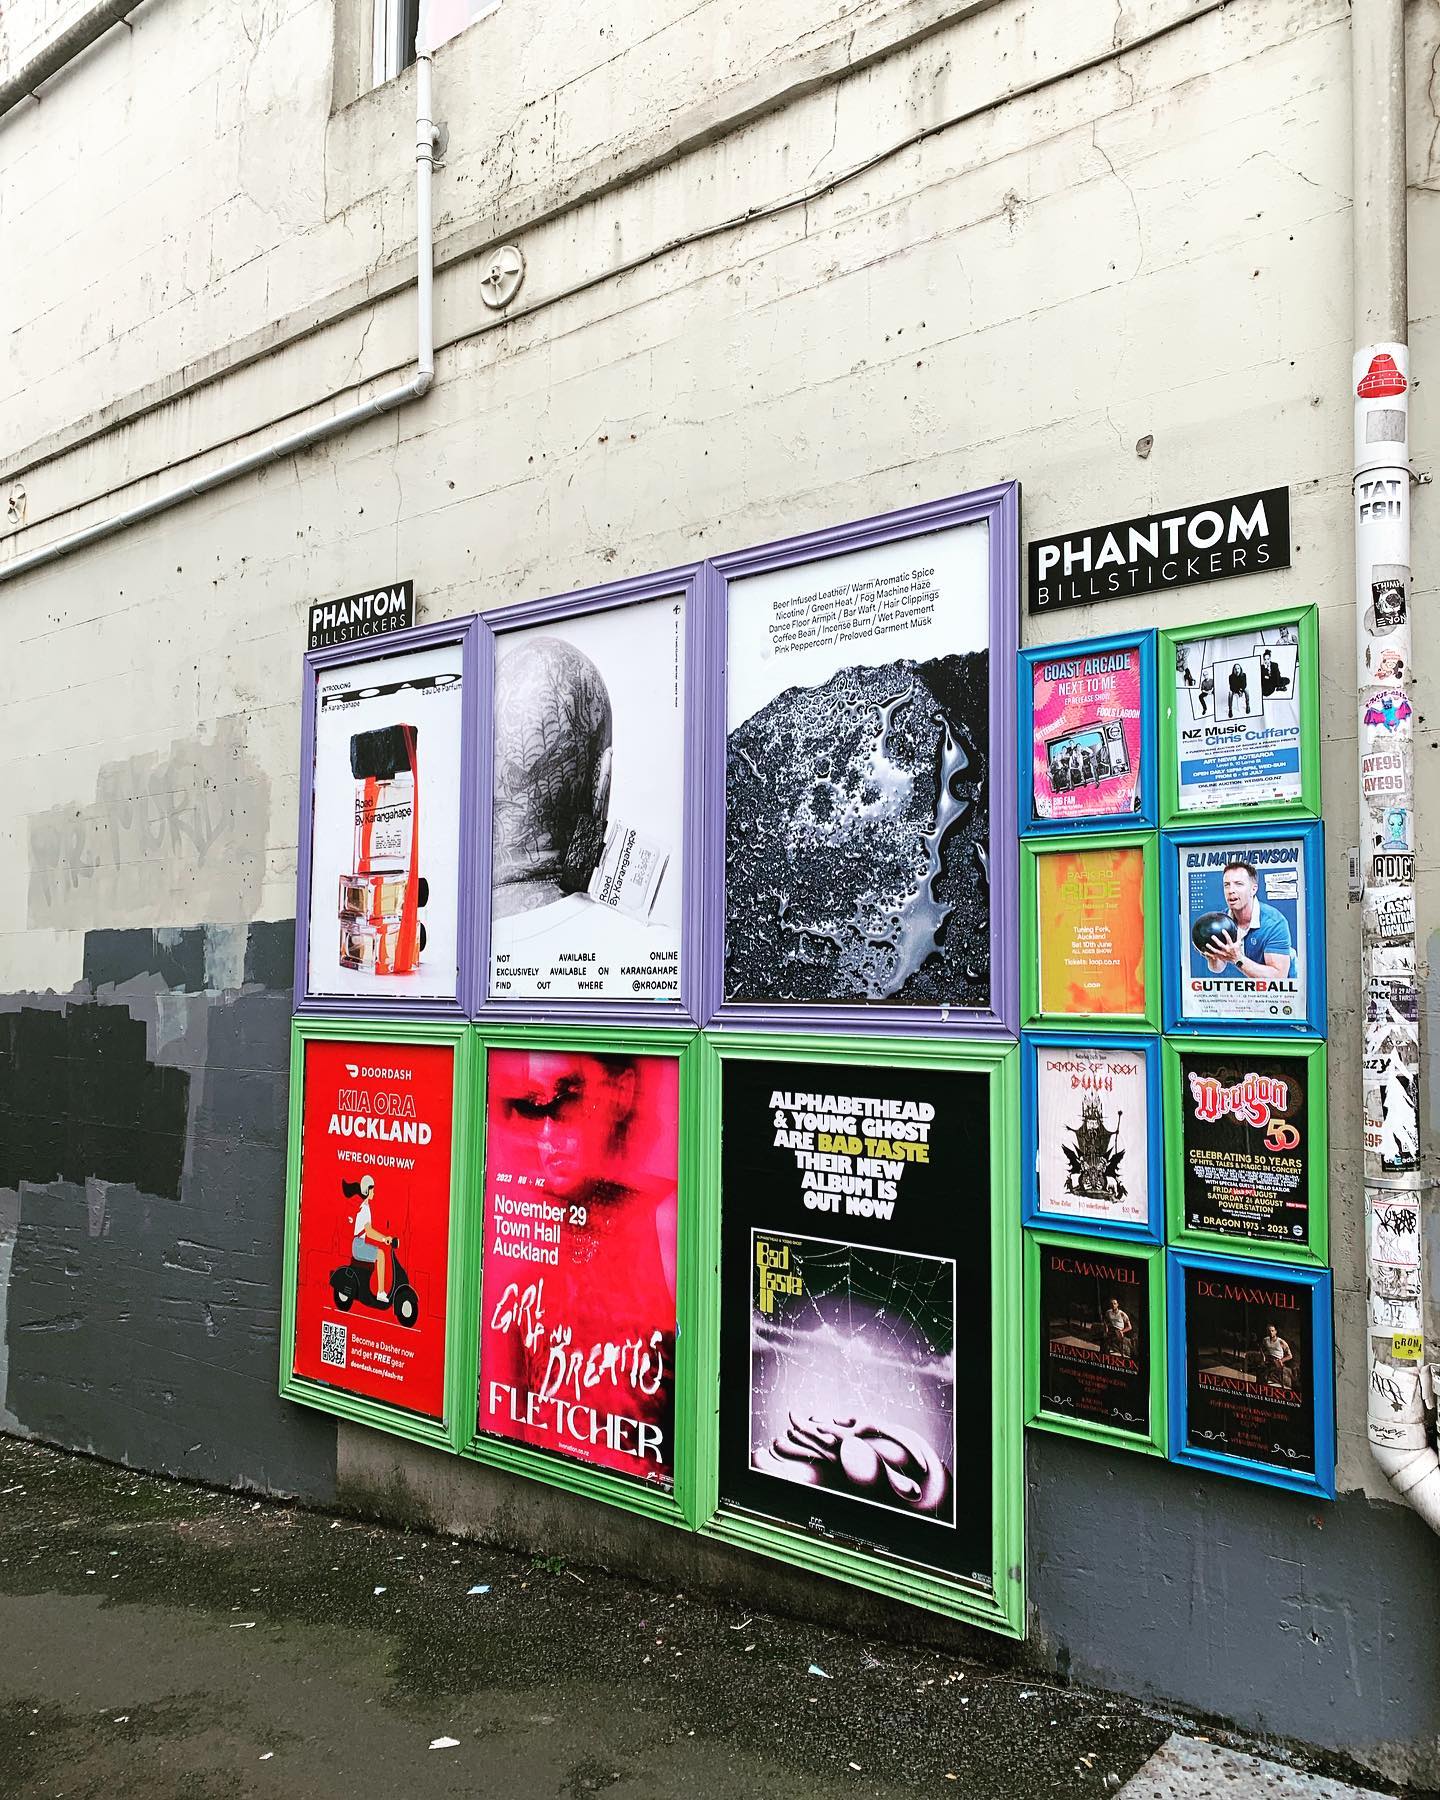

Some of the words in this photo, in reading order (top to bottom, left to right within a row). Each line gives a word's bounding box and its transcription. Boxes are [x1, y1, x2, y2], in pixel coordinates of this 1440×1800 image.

[1360, 480, 1401, 499] TAT
[1038, 499, 1269, 582] PHANTOM
[1039, 543, 1269, 605] BILLSTICKERS
[773, 601, 789, 610] Beer
[790, 594, 817, 606] Infused
[852, 580, 873, 591] Warm
[875, 573, 910, 587] Aromatic
[912, 568, 934, 580] Spice
[776, 608, 804, 620] Nicotine
[812, 602, 833, 612] Green
[835, 598, 852, 607] Heat
[860, 593, 875, 603] Fog
[876, 587, 908, 598] Machine
[910, 580, 930, 591] Haze
[313, 586, 405, 632] PHANTOM
[769, 622, 790, 633] Dance
[792, 617, 810, 627] Floor
[812, 612, 836, 624] Armpit
[844, 609, 856, 618] Bar
[858, 605, 876, 614] Waft
[883, 600, 899, 609] Hair
[901, 591, 939, 605] Clippings
[312, 614, 406, 647] BILLSTICKERS
[772, 633, 796, 644] Coffee
[798, 629, 815, 638] Bean
[822, 623, 851, 634] Incense
[853, 619, 870, 628] Burn
[878, 612, 893, 621] Wet
[895, 604, 934, 618] Pavement
[775, 646, 789, 654] Pink
[790, 637, 832, 652] Peppercorn
[840, 629, 872, 641] Preloved
[875, 623, 908, 635] Garment
[910, 617, 932, 628] Musk
[1044, 661, 1081, 681] COAST
[1084, 653, 1131, 676] ARCADE
[322, 682, 351, 692] INTRODUCING
[442, 683, 462, 692] Parfum
[1059, 680, 1083, 695] NEXT
[1087, 678, 1098, 692] TO
[1102, 676, 1116, 690] ME
[329, 701, 360, 711] Karangahape
[1183, 729, 1201, 739] NZ
[1205, 724, 1246, 736] Music
[1206, 734, 1241, 745] Chris
[1245, 727, 1299, 740] Cuffaro
[1363, 755, 1401, 773] AYE95
[1364, 775, 1403, 791] AYE95
[356, 796, 373, 810] Road
[355, 815, 363, 827] By
[365, 808, 411, 823] Karangahape
[613, 830, 636, 892] Karangahape
[1187, 853, 1206, 868] ELI
[1207, 848, 1299, 866] MATTHEWSON
[599, 876, 612, 902] Road
[610, 893, 620, 906] By
[497, 954, 510, 962] NOT
[559, 953, 596, 961] AVAILABLE
[650, 952, 678, 960] ONLINE
[497, 968, 539, 976] EXCLUSIVELY
[550, 967, 586, 975] AVAILABLE
[598, 967, 609, 975] ON
[621, 966, 678, 975] KARANGAHAPE
[537, 981, 551, 989] OUT
[578, 981, 603, 989] WHERE
[632, 980, 678, 991] @KROADNZ
[1191, 981, 1297, 992] GUTTERBALL
[361, 1067, 412, 1080] DOORDASH
[338, 1089, 371, 1113] KIA
[374, 1092, 416, 1117] ORA
[769, 1091, 935, 1121] ALPHABETHEAD
[1188, 1072, 1289, 1128] Dragon
[328, 1114, 432, 1145] AUCKLAND
[774, 1110, 788, 1129] &
[791, 1111, 856, 1135] YOUNG
[862, 1120, 930, 1142] GHOST
[1264, 1119, 1300, 1151] 50
[338, 1150, 362, 1162] WE'RE
[363, 1154, 375, 1165] ON
[377, 1155, 399, 1167] OUR
[396, 1158, 415, 1169] WAY
[774, 1130, 815, 1151] ARE
[818, 1134, 863, 1156] BAD
[864, 1138, 930, 1163] TASTE
[1190, 1150, 1251, 1163] CELEBRATING
[1255, 1156, 1266, 1164] 50
[1269, 1157, 1302, 1167] YEARS
[795, 1151, 852, 1175] THEIR
[857, 1159, 904, 1180] NEW
[1272, 1166, 1301, 1174] CONCERT
[801, 1172, 872, 1196] ALBUM
[878, 1181, 897, 1200] IS
[494, 1194, 566, 1222] November
[569, 1205, 586, 1226] 29
[804, 1191, 841, 1213] OUT
[846, 1196, 895, 1221] NOW
[1208, 1193, 1243, 1203] SATURDAY
[1255, 1199, 1283, 1207] AUGUST
[1219, 1201, 1273, 1213] POWERSTATION
[494, 1215, 530, 1238] Town
[534, 1221, 560, 1244] Hall
[1204, 1216, 1240, 1228] DRAGON
[1243, 1221, 1258, 1230] 1973
[1268, 1225, 1288, 1234] 2023
[493, 1237, 558, 1266] Auckland
[757, 1242, 788, 1269] Bad
[757, 1265, 802, 1296] Taste
[1074, 1261, 1140, 1285] MAXWELL
[1225, 1284, 1300, 1311] MAXWELL
[351, 1348, 362, 1356] and
[363, 1350, 372, 1360] get
[373, 1353, 391, 1365] FREE
[392, 1359, 404, 1369] gear
[352, 1334, 374, 1348] Become
[380, 1342, 401, 1354] Dasher
[401, 1350, 414, 1358] now
[1260, 1385, 1302, 1403] PERSON
[489, 1381, 664, 1463] FLETCHER
